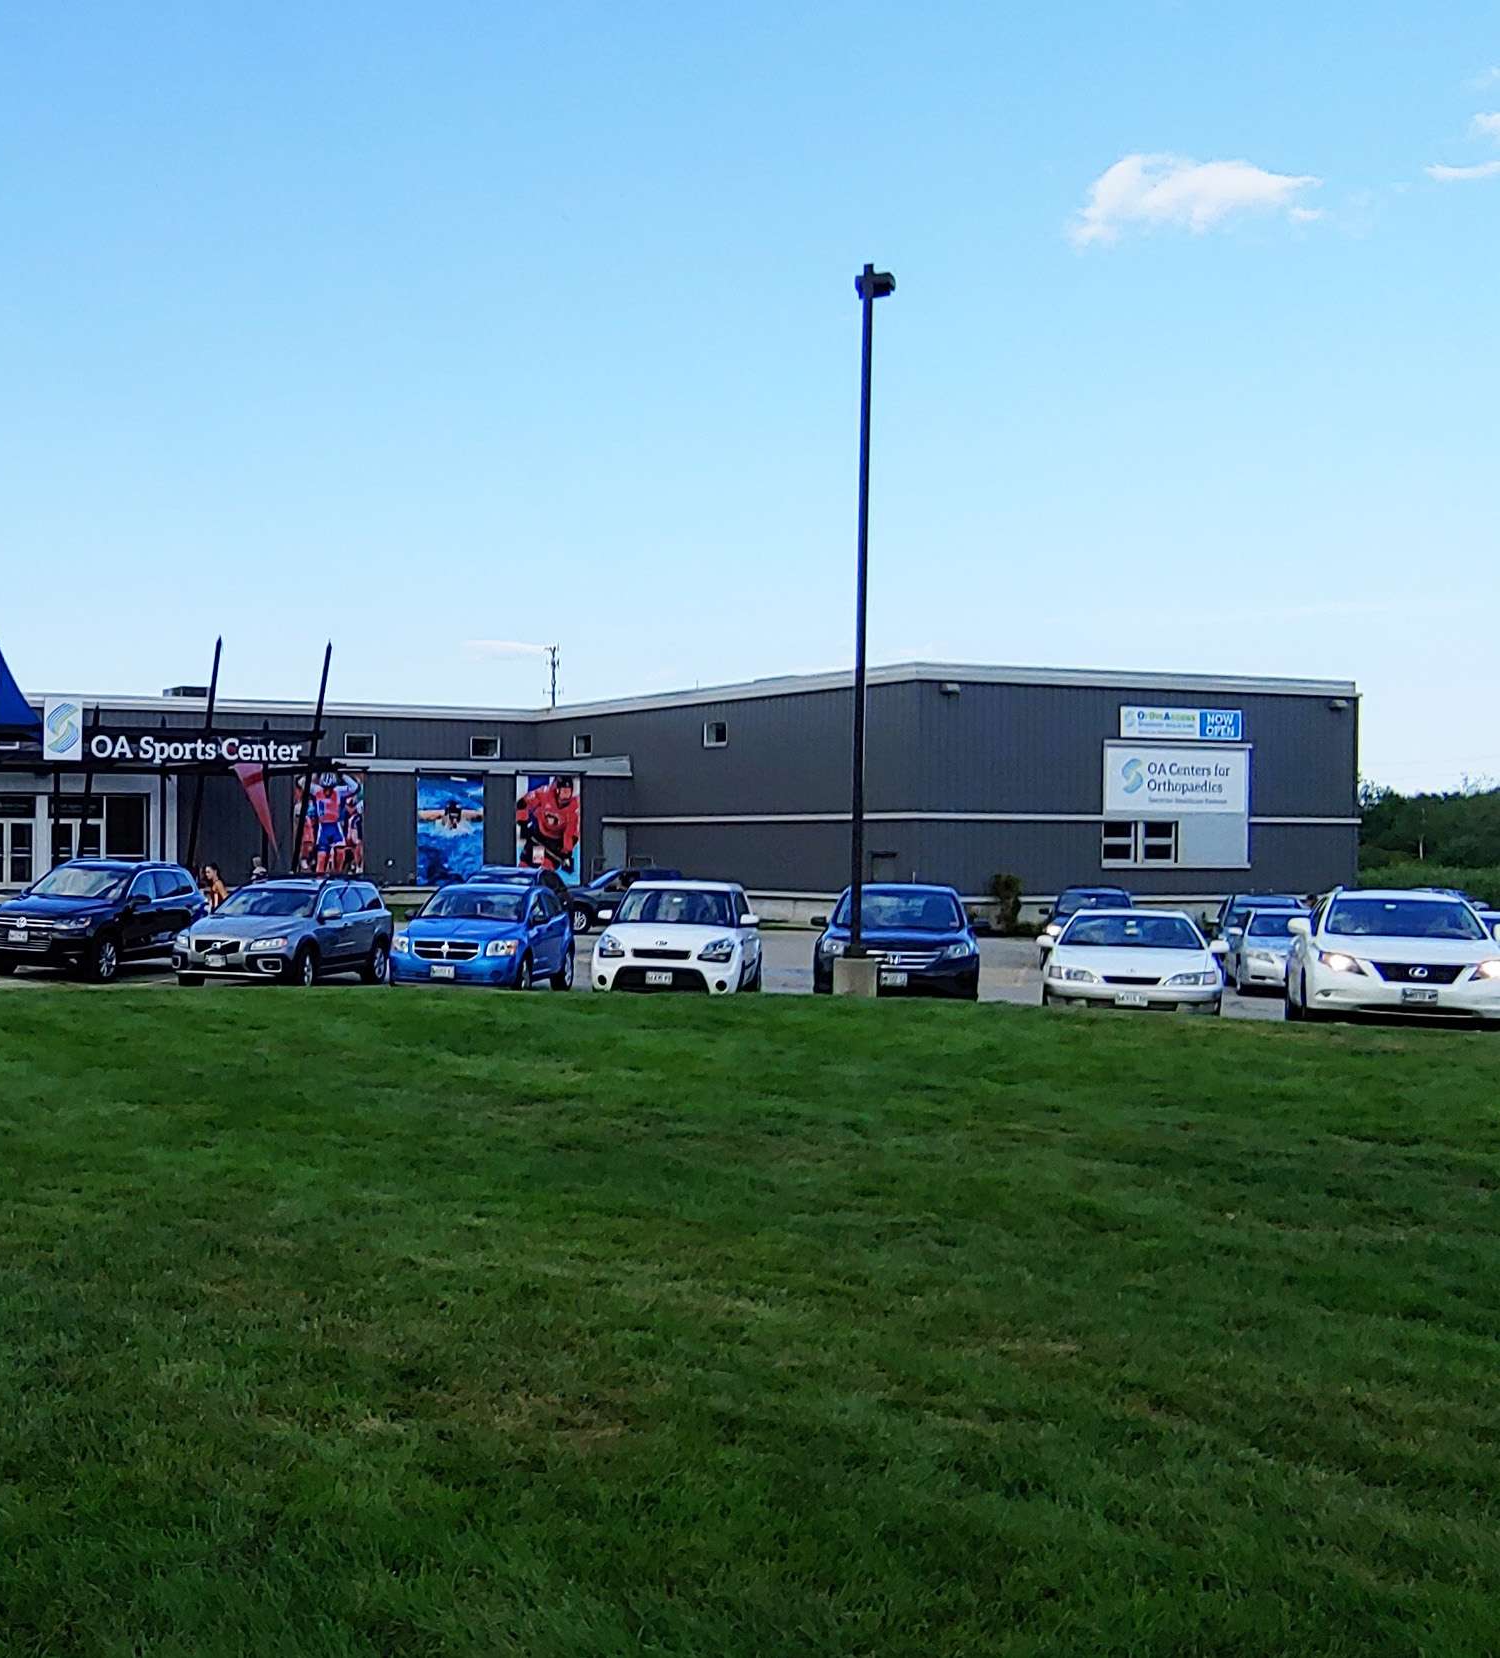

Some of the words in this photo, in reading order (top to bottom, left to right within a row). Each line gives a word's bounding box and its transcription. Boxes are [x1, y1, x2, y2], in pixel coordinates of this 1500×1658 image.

[1206, 712, 1234, 725] NOW
[1205, 724, 1235, 737] OPEN
[91, 735, 134, 759] OA
[139, 736, 216, 764] Sports
[220, 737, 302, 761] Center
[1147, 761, 1167, 776] OA
[1168, 762, 1212, 777] Centers
[1214, 762, 1231, 777] for
[1147, 778, 1223, 795] Orthopaedics
